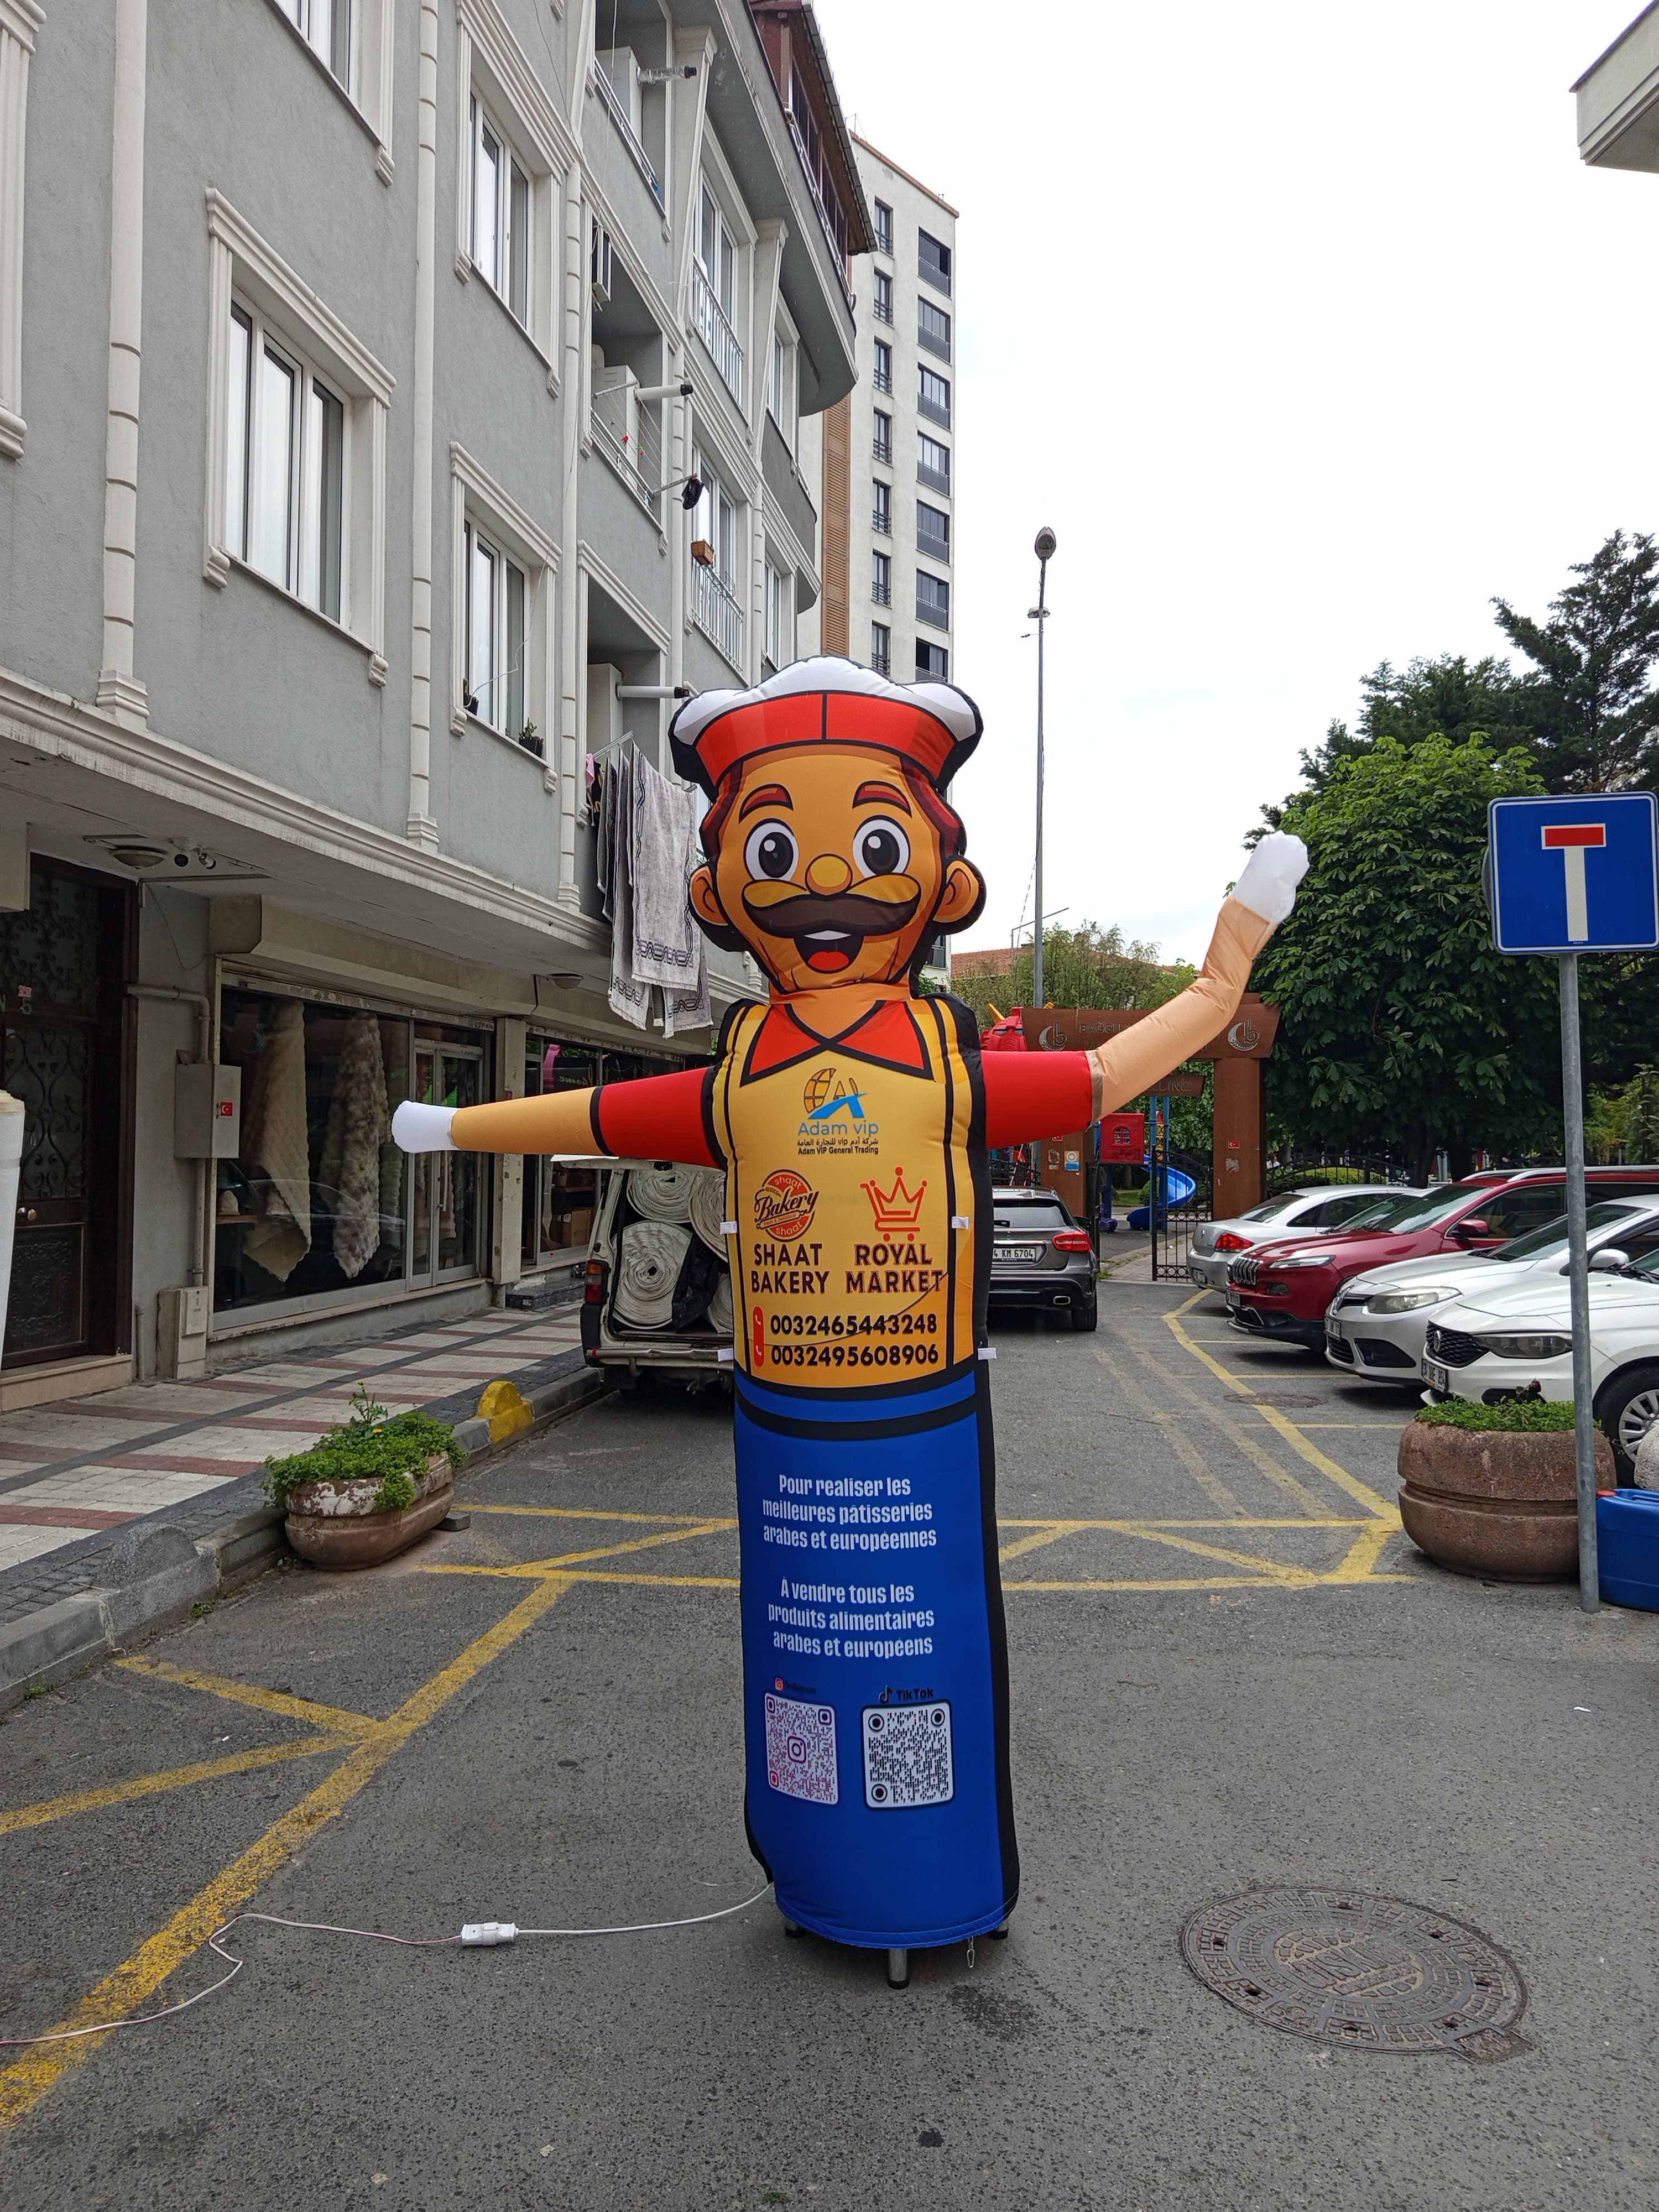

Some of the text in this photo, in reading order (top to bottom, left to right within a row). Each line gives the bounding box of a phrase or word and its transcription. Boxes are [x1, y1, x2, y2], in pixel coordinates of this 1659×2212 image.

[798, 1120, 879, 1137] Adam vip
[838, 1138, 848, 1146] vip
[854, 1146, 879, 1155] Trading
[862, 1138, 879, 1146] شركة
[775, 1176, 802, 1189] shaat
[754, 1188, 820, 1222] Bakery
[776, 1220, 803, 1235] shaat
[754, 1243, 822, 1266] SHAAT
[853, 1242, 933, 1266] ROYAL
[1001, 1249, 1011, 1258] KM
[1014, 1249, 1033, 1258] 6704
[751, 1270, 830, 1294] BAKERY
[844, 1269, 944, 1293] MARKET
[770, 1313, 937, 1335] 0032465443248
[771, 1344, 939, 1366] 0032495608906
[779, 1474, 911, 1497] Pour realiser les
[763, 1499, 933, 1525] meilleures pâtisseries
[764, 1525, 937, 1552] arabes et européennes
[792, 1582, 846, 1603] vendre
[849, 1585, 886, 1604] tous
[890, 1584, 914, 1602] les
[768, 1604, 935, 1631] produits alimentaires
[773, 1631, 933, 1659] arabes et européens
